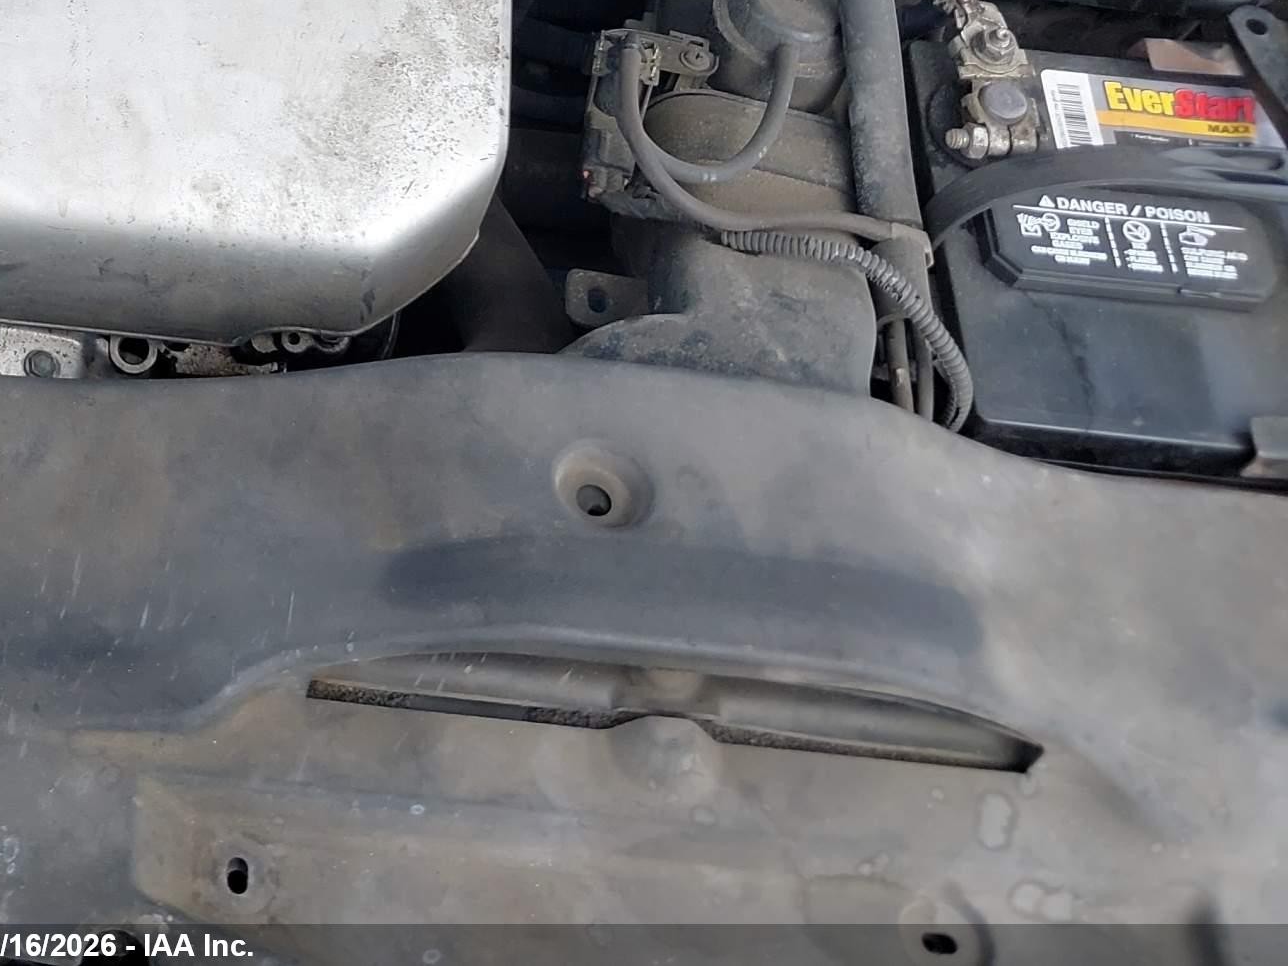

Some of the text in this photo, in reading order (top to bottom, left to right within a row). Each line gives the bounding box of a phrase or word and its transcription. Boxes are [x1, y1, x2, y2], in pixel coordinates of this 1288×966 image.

[1103, 80, 1256, 123] EverStart
[1207, 123, 1251, 135] MAXX
[1056, 196, 1211, 224] DANGER / POISON
